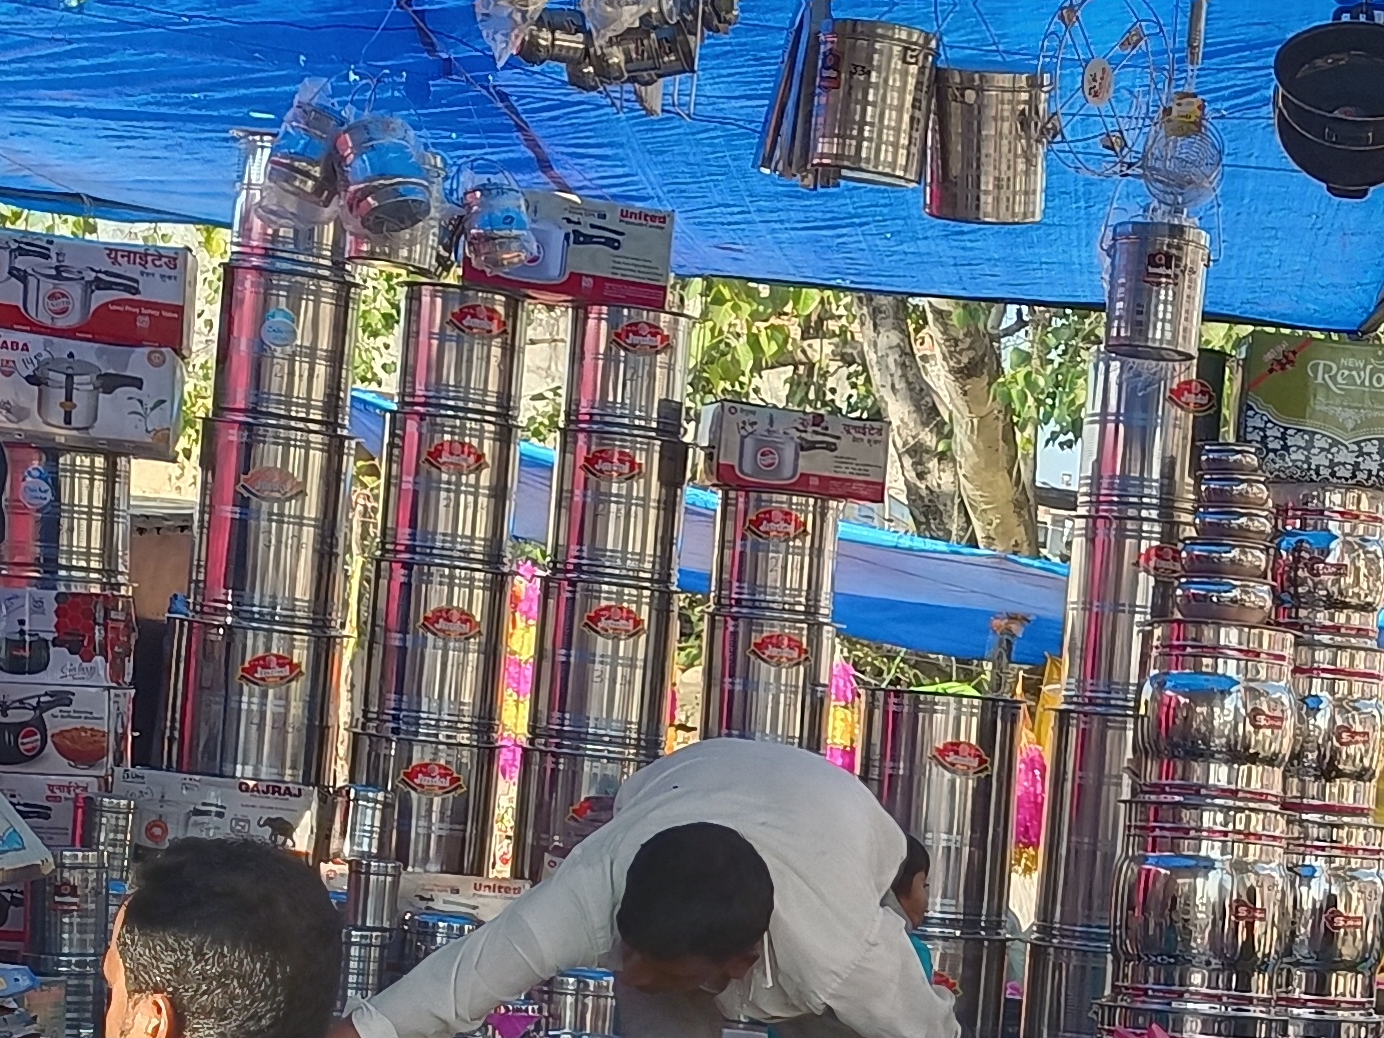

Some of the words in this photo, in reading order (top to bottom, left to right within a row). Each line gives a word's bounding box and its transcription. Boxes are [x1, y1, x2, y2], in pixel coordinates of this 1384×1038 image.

[620, 208, 668, 224] United
[1340, 357, 1365, 368] NEW
[238, 781, 302, 798] GAJRAJ
[473, 882, 522, 895] United
